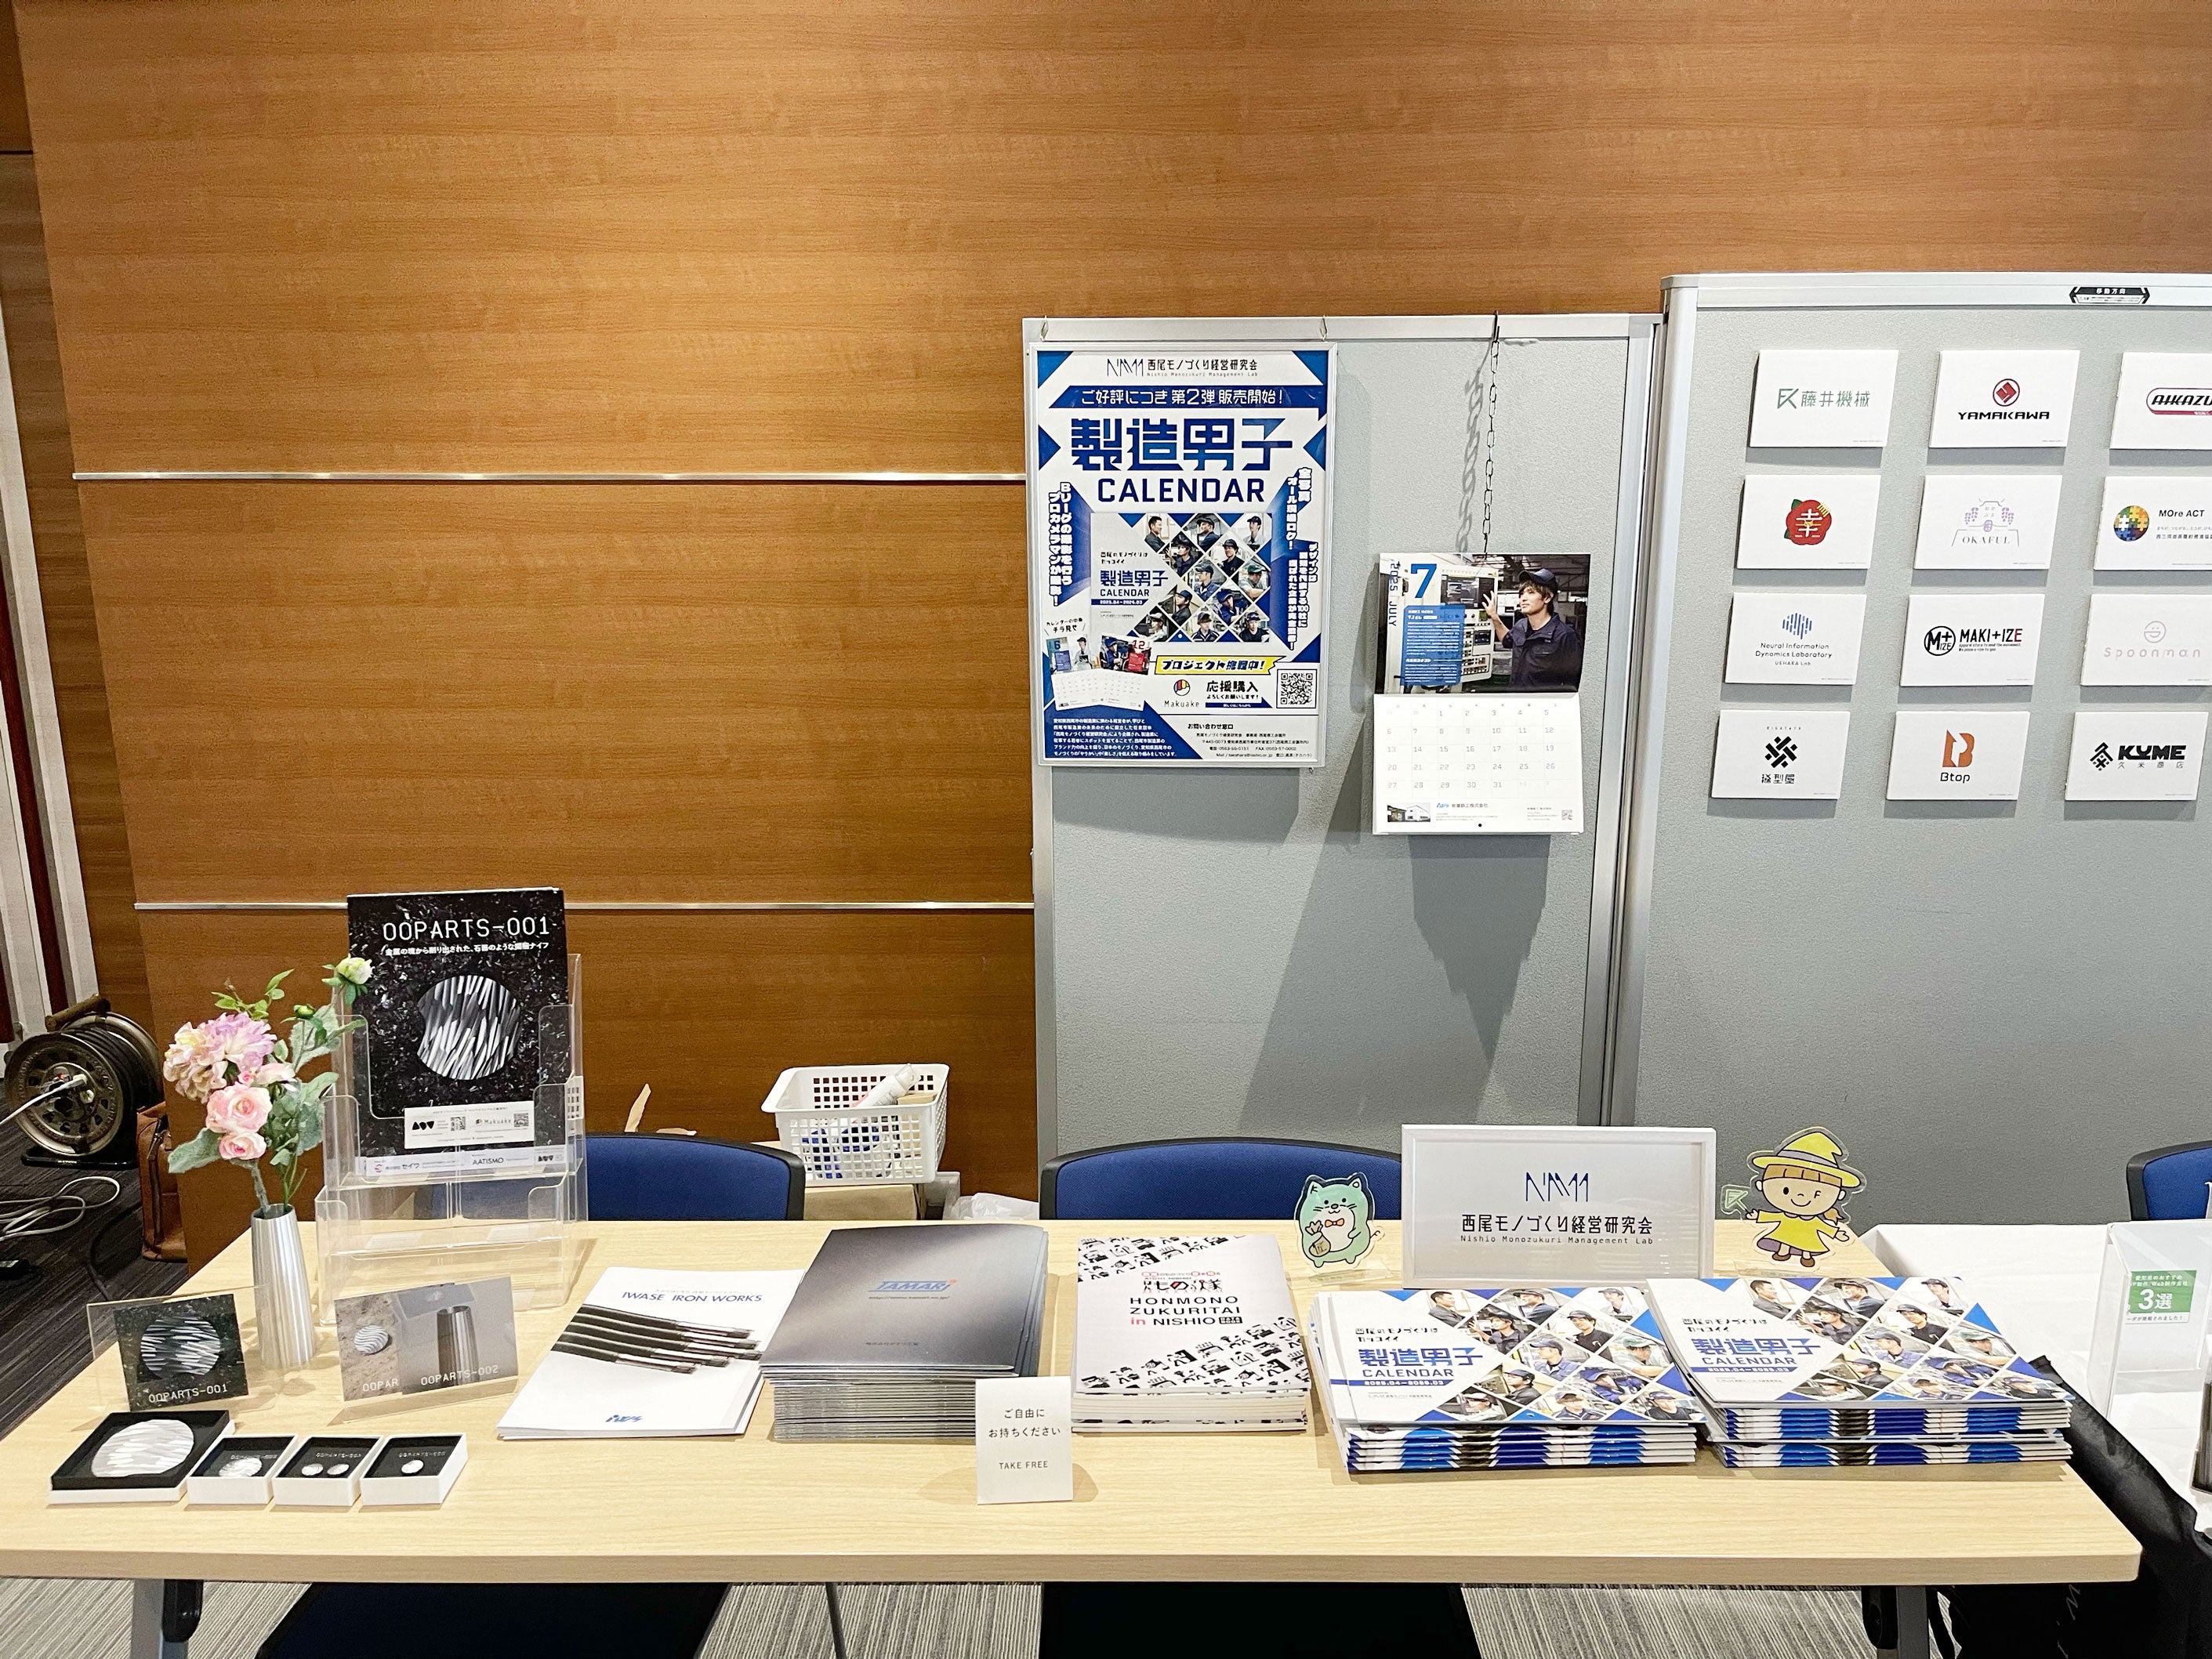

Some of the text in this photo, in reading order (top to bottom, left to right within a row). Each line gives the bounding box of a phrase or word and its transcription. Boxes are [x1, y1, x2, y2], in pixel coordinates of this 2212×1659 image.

[1148, 359, 1258, 371] 西尾モノづくり経営研究会
[1082, 389, 1169, 405] ご好評につき
[1172, 388, 1216, 405] 第2弾
[1800, 390, 1870, 408] 藤井機械
[1957, 411, 2050, 420] YAMAKAWA
[1072, 418, 1293, 471] 製造男子
[1097, 478, 1264, 502] CALENDAR
[1101, 570, 1168, 586] 製造男子
[1411, 563, 1438, 599] 7
[1388, 601, 1397, 626] JULY
[1960, 628, 2023, 643] MAKI+IZE
[1755, 650, 1833, 659] Dynamics Laboratory
[1206, 680, 1259, 693] 応援購入
[1461, 1214, 1653, 1235] 西尾モノづくり経営研究会
[1568, 1237, 1628, 1245] Management
[622, 1291, 665, 1301] IWASE
[1130, 1295, 1238, 1306] HONMONO
[2138, 1288, 2173, 1310] 3選
[1130, 1306, 1240, 1315] ZUKURITAI
[1153, 1317, 1216, 1326] NISHIO
[1691, 1338, 1821, 1355] 製造男子
[1358, 1347, 1483, 1367] 製造男子
[1362, 1368, 1455, 1378] CALENDAR
[1004, 1408, 1045, 1418] ご自由に
[988, 1426, 1061, 1438] お持ちください
